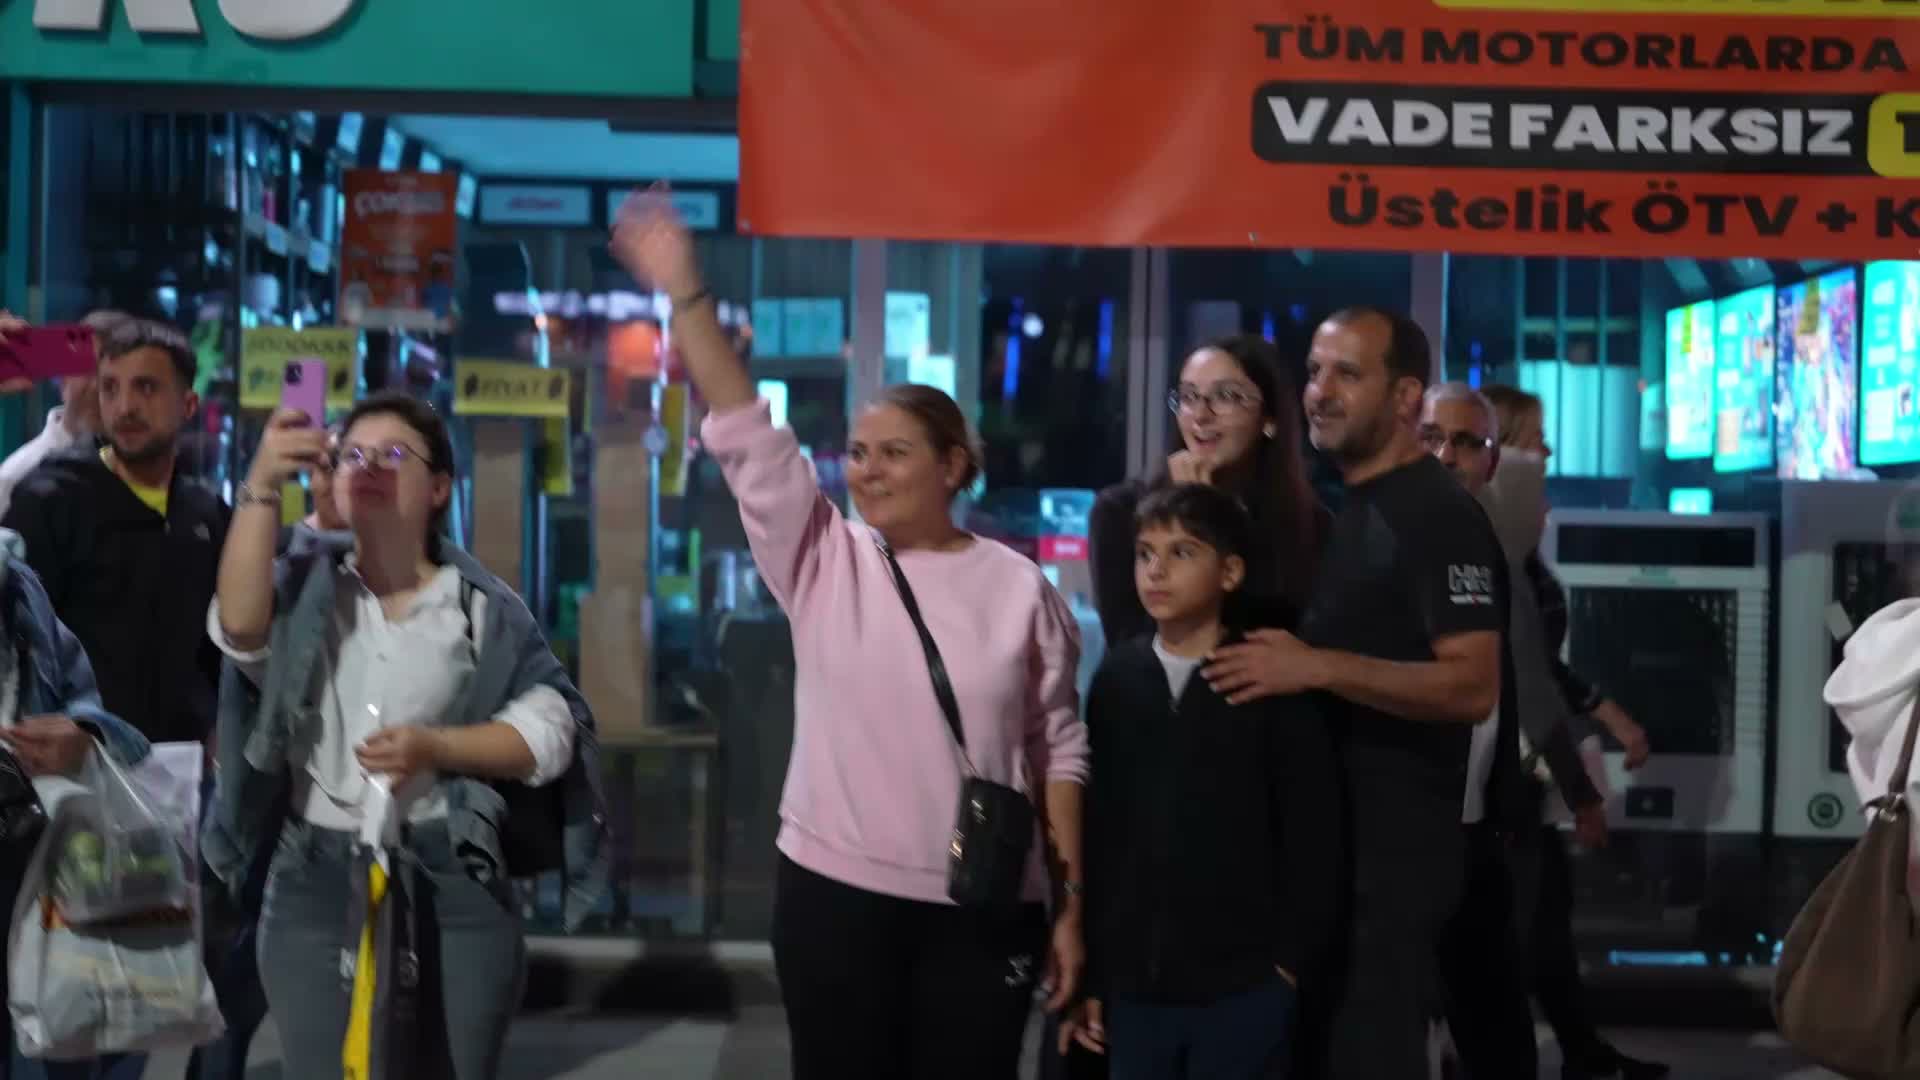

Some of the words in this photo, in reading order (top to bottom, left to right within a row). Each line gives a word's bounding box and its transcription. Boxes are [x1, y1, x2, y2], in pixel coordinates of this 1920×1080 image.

[1254, 15, 1404, 63] TÜM
[1421, 29, 1908, 74] MOTORLARDA
[1267, 96, 1493, 148] VADE
[1509, 103, 1854, 155] FARKSIZ
[1328, 172, 1611, 233] Üstelik
[1631, 180, 1799, 237] ÖTV
